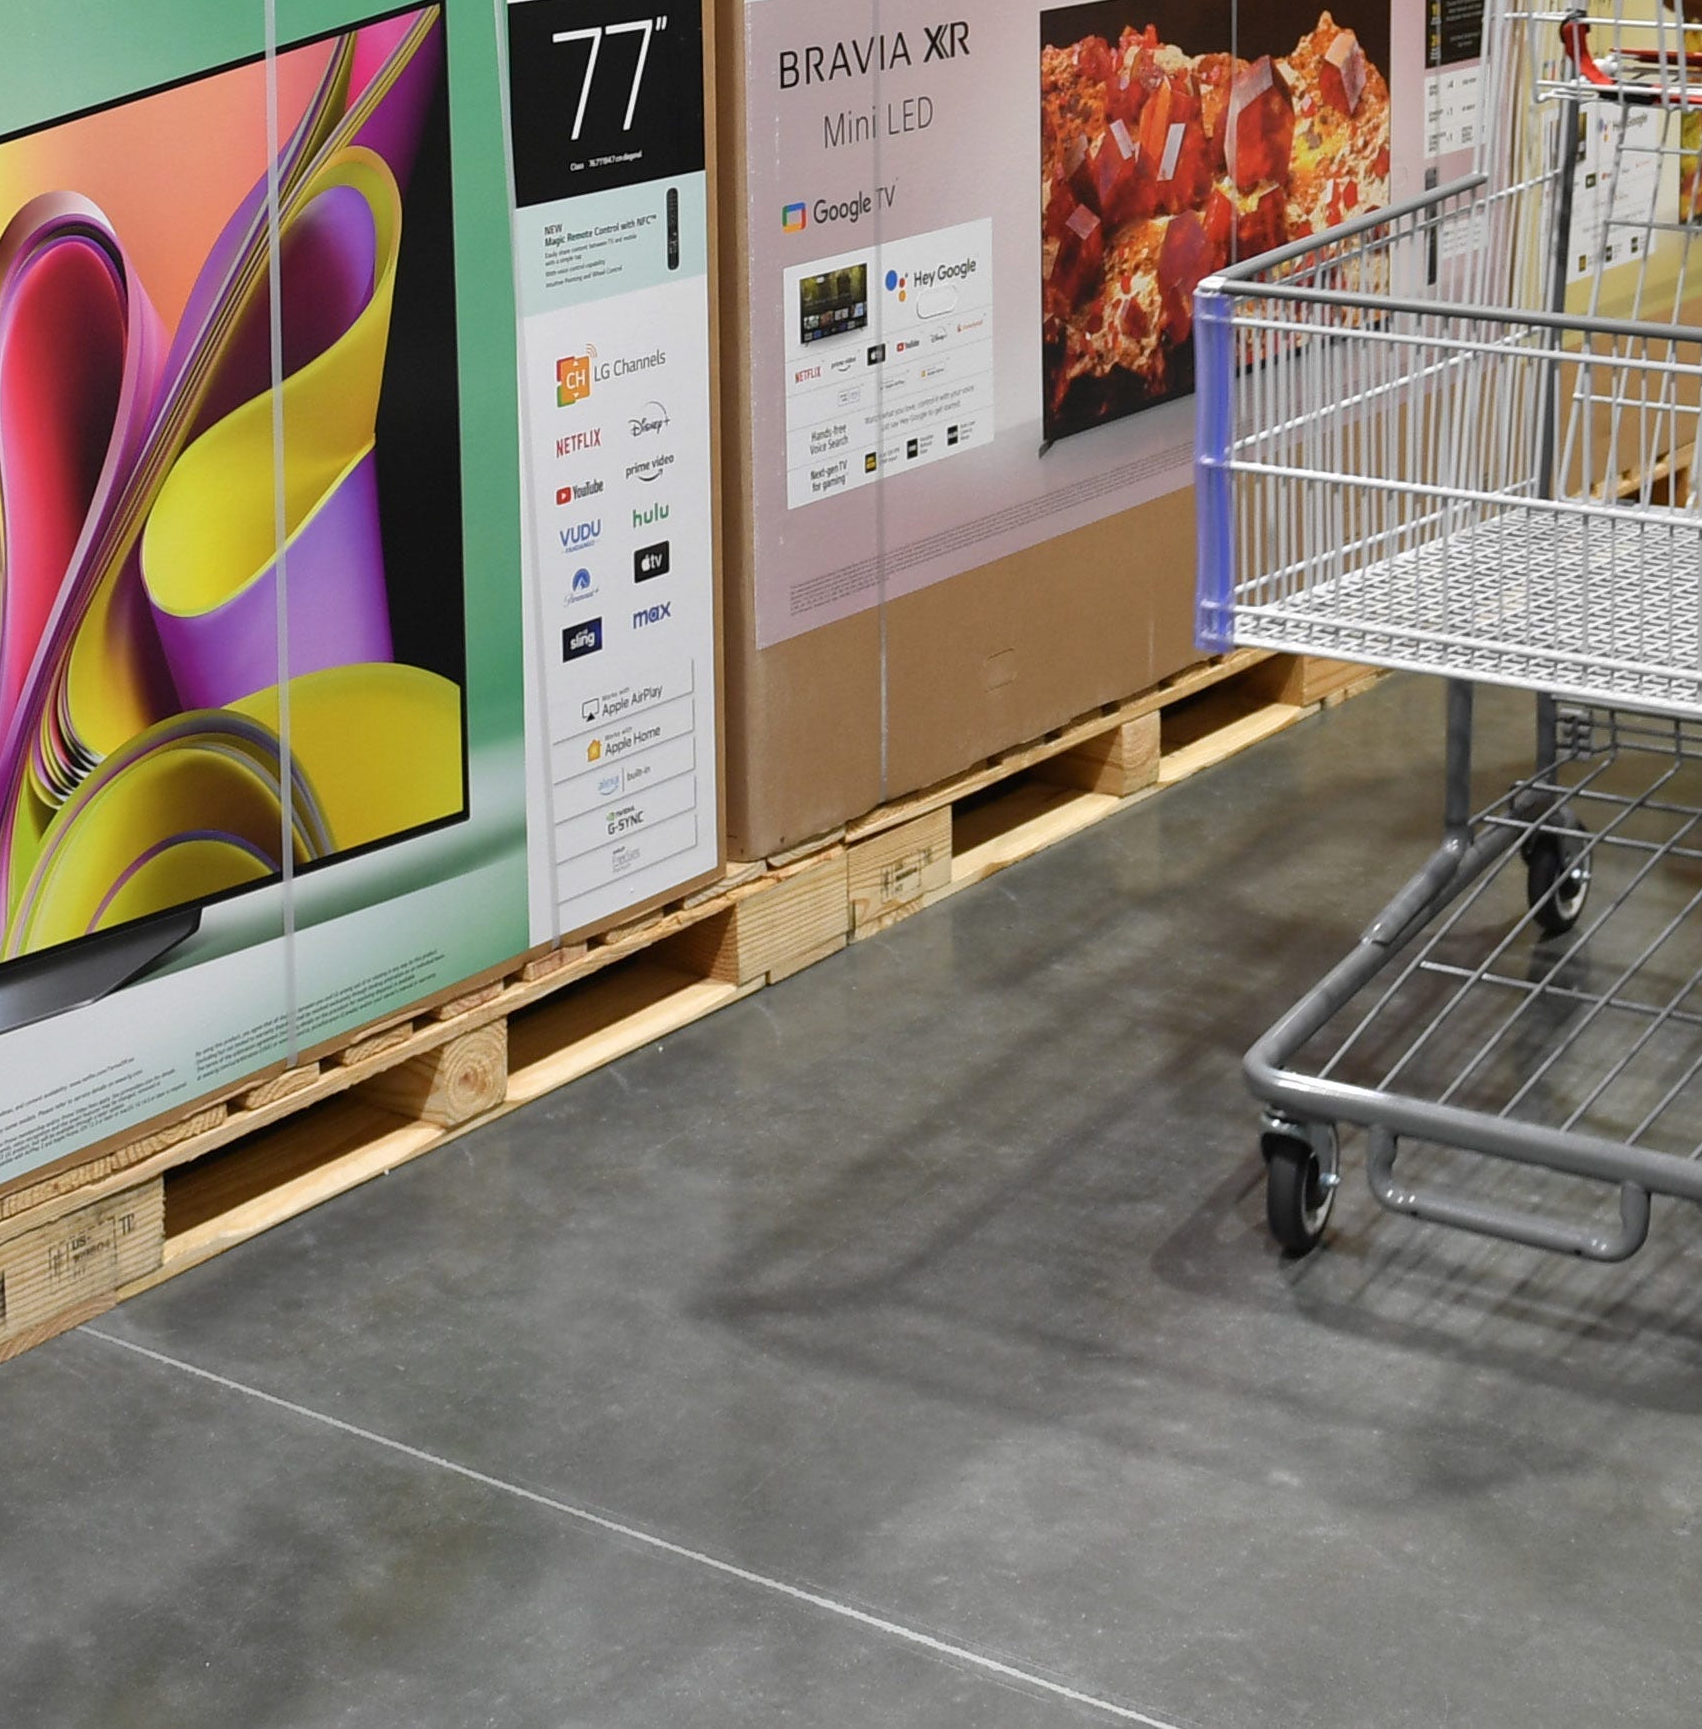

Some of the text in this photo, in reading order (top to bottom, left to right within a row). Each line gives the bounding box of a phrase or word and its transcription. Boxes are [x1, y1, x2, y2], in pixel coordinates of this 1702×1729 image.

[779, 30, 912, 91] BRAVIA
[552, 15, 668, 140] 77"
[822, 95, 935, 150] Mini LED
[812, 182, 897, 226] Google TV
[544, 223, 563, 235] NEW
[544, 233, 566, 247] Magic
[567, 228, 593, 244] Remote
[594, 222, 620, 239] Control
[620, 218, 635, 232] with
[913, 258, 977, 289] Hey Google
[594, 350, 666, 382] LG Channels
[556, 428, 601, 458] NETFLIX
[625, 452, 675, 478] prime video
[572, 478, 604, 501] YouTube
[632, 502, 670, 528] hulu
[559, 518, 601, 547] VUDU
[632, 601, 671, 629] max
[602, 684, 663, 718] Apple AirPlay
[605, 725, 661, 758] Apple Home
[608, 810, 644, 836] G-SYNC
